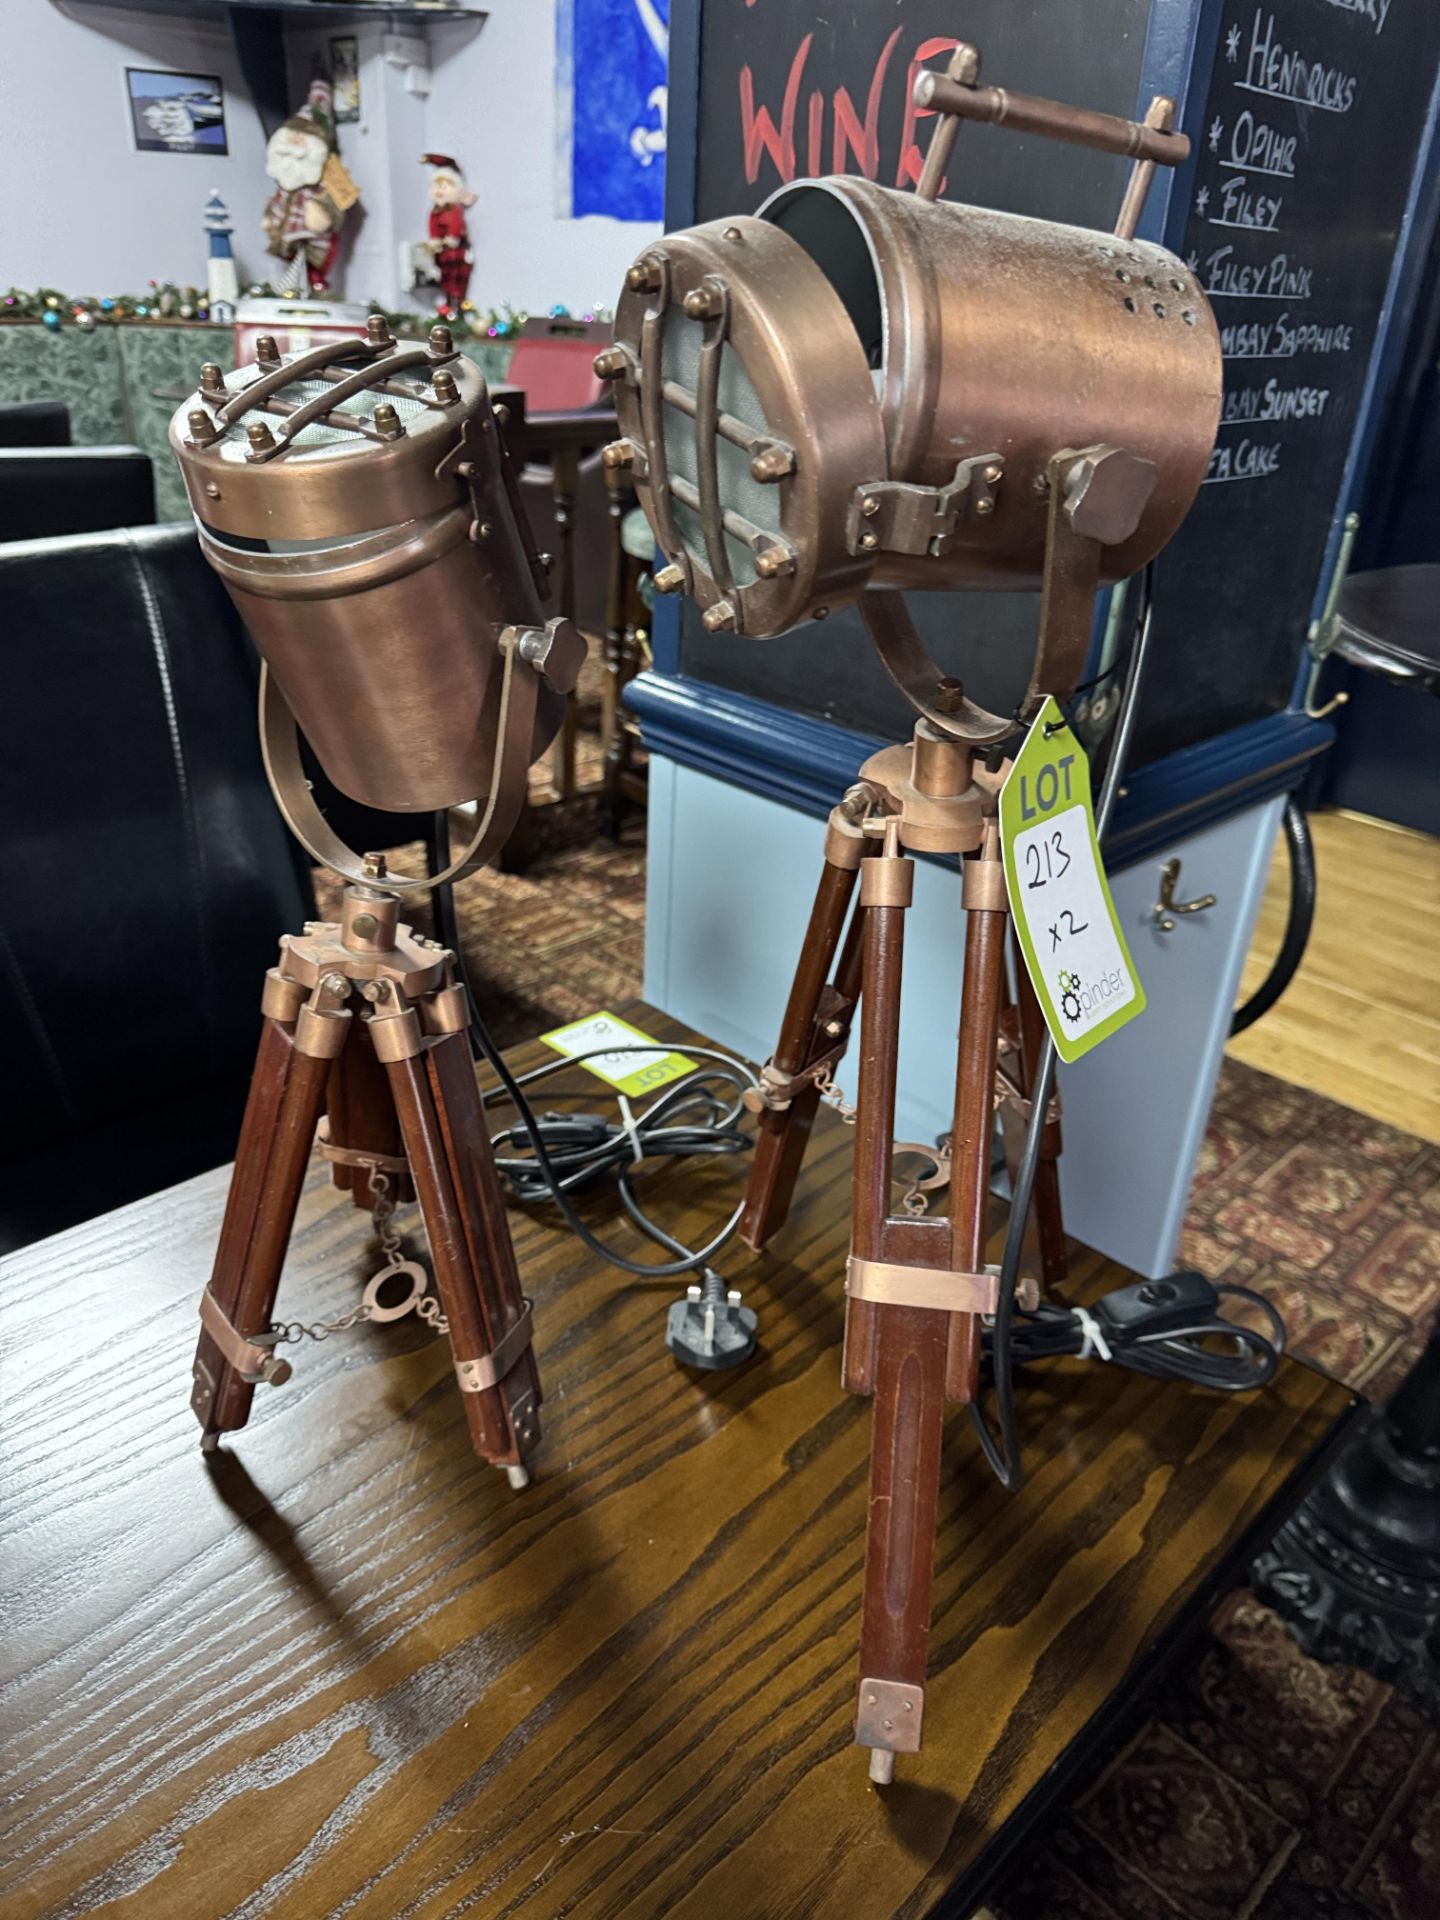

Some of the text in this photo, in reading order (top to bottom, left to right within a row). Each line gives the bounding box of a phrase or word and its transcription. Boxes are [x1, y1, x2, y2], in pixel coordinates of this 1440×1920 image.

[740, 26, 960, 195] WINE
[1220, 176, 1282, 231] FILEY
[1205, 245, 1313, 298] FILEY PINK
[1272, 312, 1352, 356] SAPPHIRE
[1259, 377, 1330, 420] SUNSET
[1234, 438, 1281, 475] CAKE
[1020, 754, 1075, 822] LOT
[1026, 831, 1071, 889] 213
[1080, 968, 1124, 1019] pinder
[636, 1062, 678, 1088] LOT
